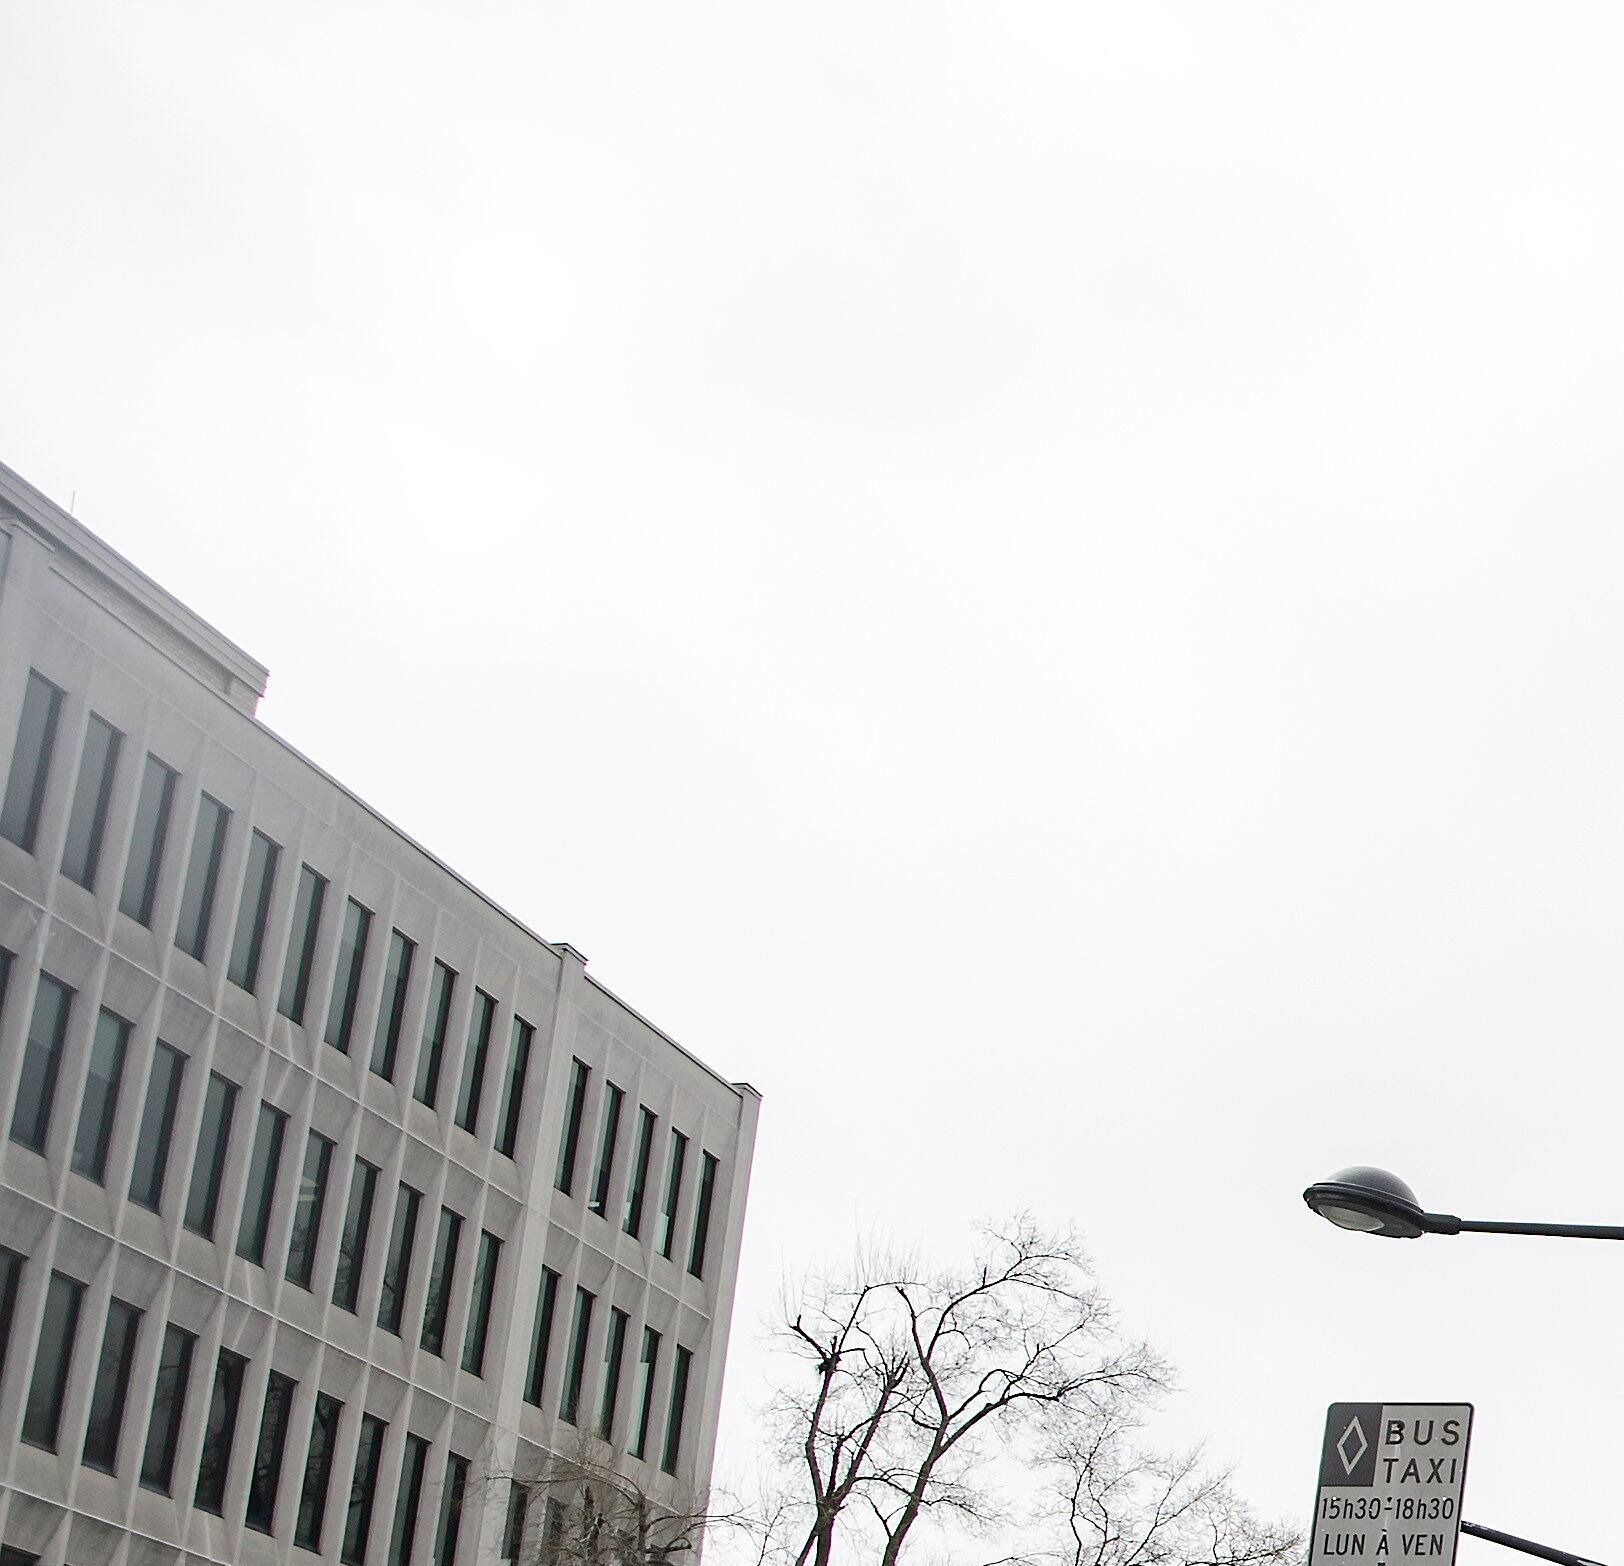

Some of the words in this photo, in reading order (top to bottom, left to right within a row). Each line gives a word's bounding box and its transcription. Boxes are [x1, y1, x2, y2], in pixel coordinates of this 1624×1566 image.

[1384, 1419, 1461, 1446] BUS
[1382, 1457, 1457, 1485] TAXI
[1323, 1533, 1364, 1556] LUN
[1375, 1529, 1389, 1556] À
[1401, 1533, 1444, 1556] VEN
